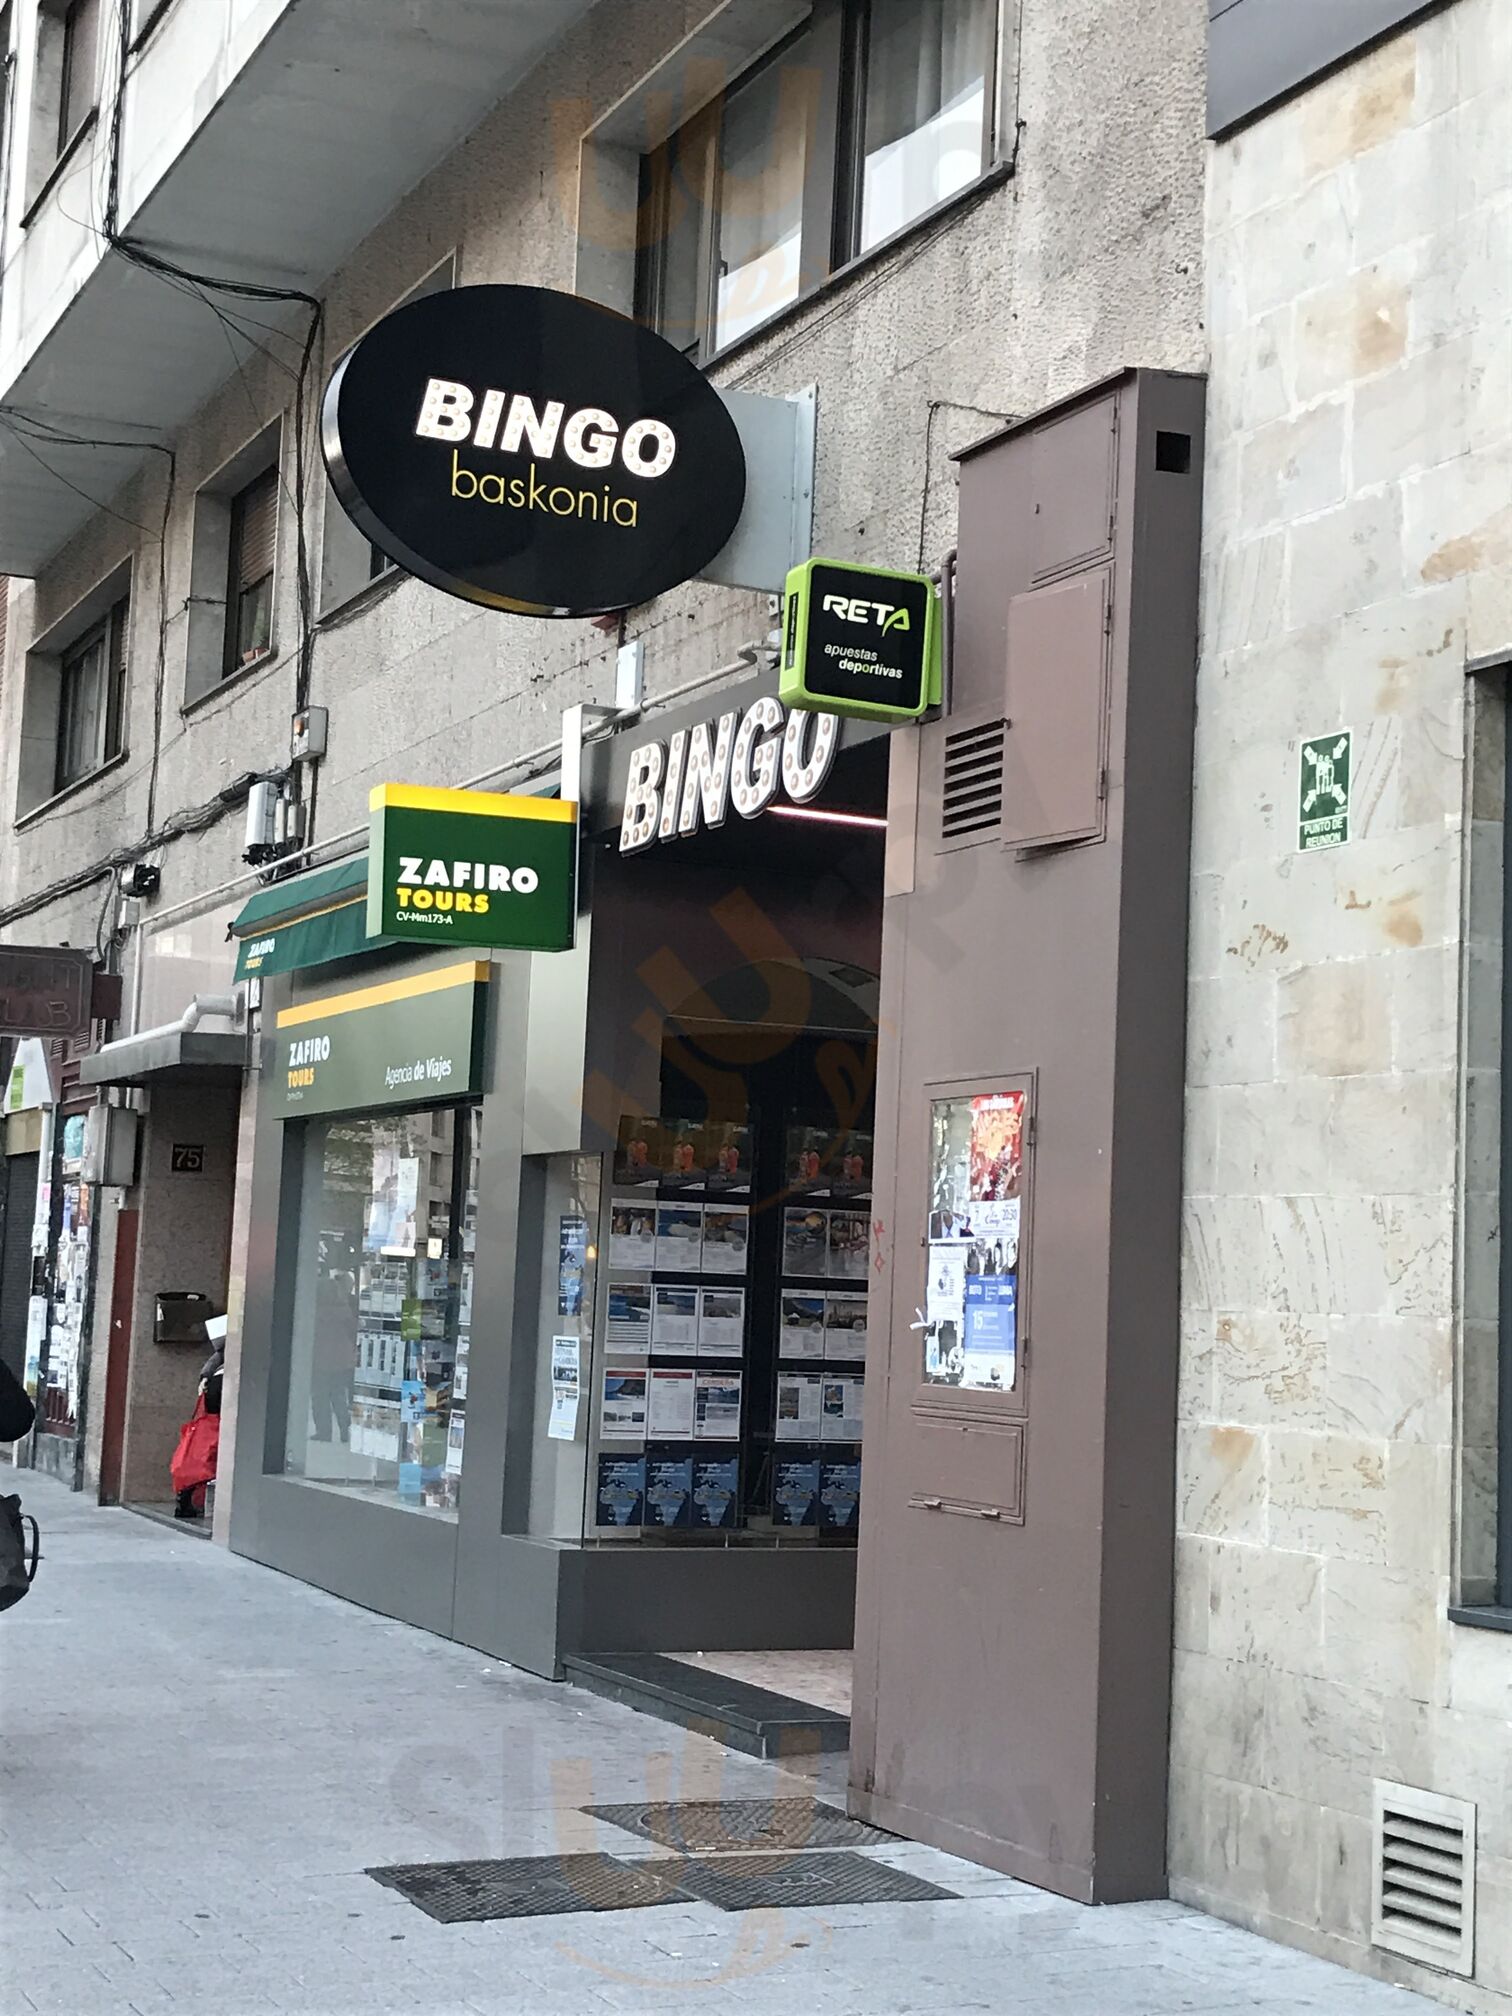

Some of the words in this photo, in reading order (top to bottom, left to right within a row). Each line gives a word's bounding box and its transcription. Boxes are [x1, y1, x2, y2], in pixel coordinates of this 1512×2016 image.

[415, 376, 677, 479] BINGO
[450, 449, 638, 529] baskonia
[822, 593, 911, 637] RETA
[824, 643, 878, 662] apuestas
[838, 658, 903, 680] deportivas
[618, 696, 842, 855] BINGO
[1304, 820, 1331, 835] PUNTO
[1332, 817, 1343, 830] DE
[1305, 831, 1341, 848] REUNION
[397, 857, 539, 894] ZAFIRO
[396, 887, 489, 914] TOURS
[396, 911, 453, 925] CV-Mm173-A
[247, 937, 276, 958] ZAFIRO
[289, 1034, 331, 1067] ZAFIRO
[287, 1067, 315, 1089] TOURS
[384, 1063, 413, 1089] Agencia
[413, 1060, 425, 1081] de
[425, 1055, 452, 1083] Viajes
[174, 1147, 200, 1168] 75
